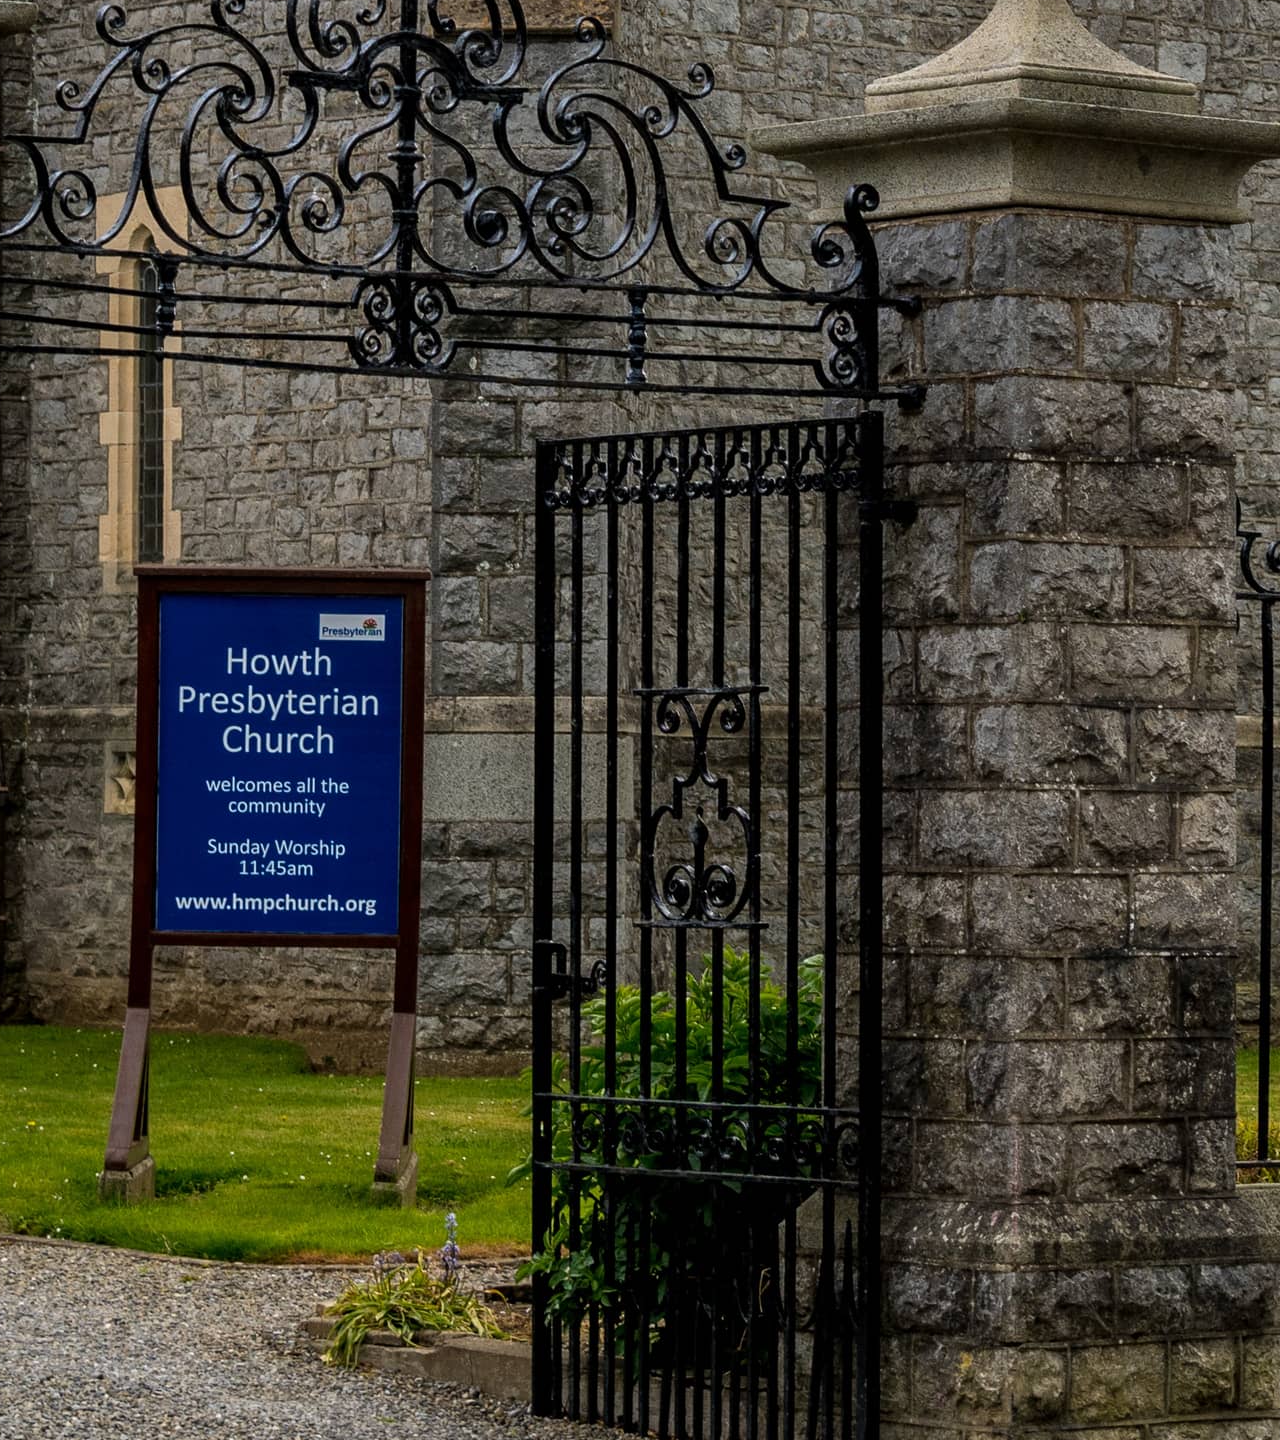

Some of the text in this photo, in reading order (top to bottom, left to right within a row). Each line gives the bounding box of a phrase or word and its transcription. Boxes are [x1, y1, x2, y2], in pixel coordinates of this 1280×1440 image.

[227, 647, 332, 676] Howth
[178, 685, 379, 721] Presbyterian
[222, 724, 334, 754] Church
[206, 776, 349, 794] welcomes all the
[228, 799, 326, 818] community
[207, 838, 346, 860] Sunday Worship
[239, 859, 314, 877] 11:45am
[175, 893, 377, 916] www.hmpchurch.org
